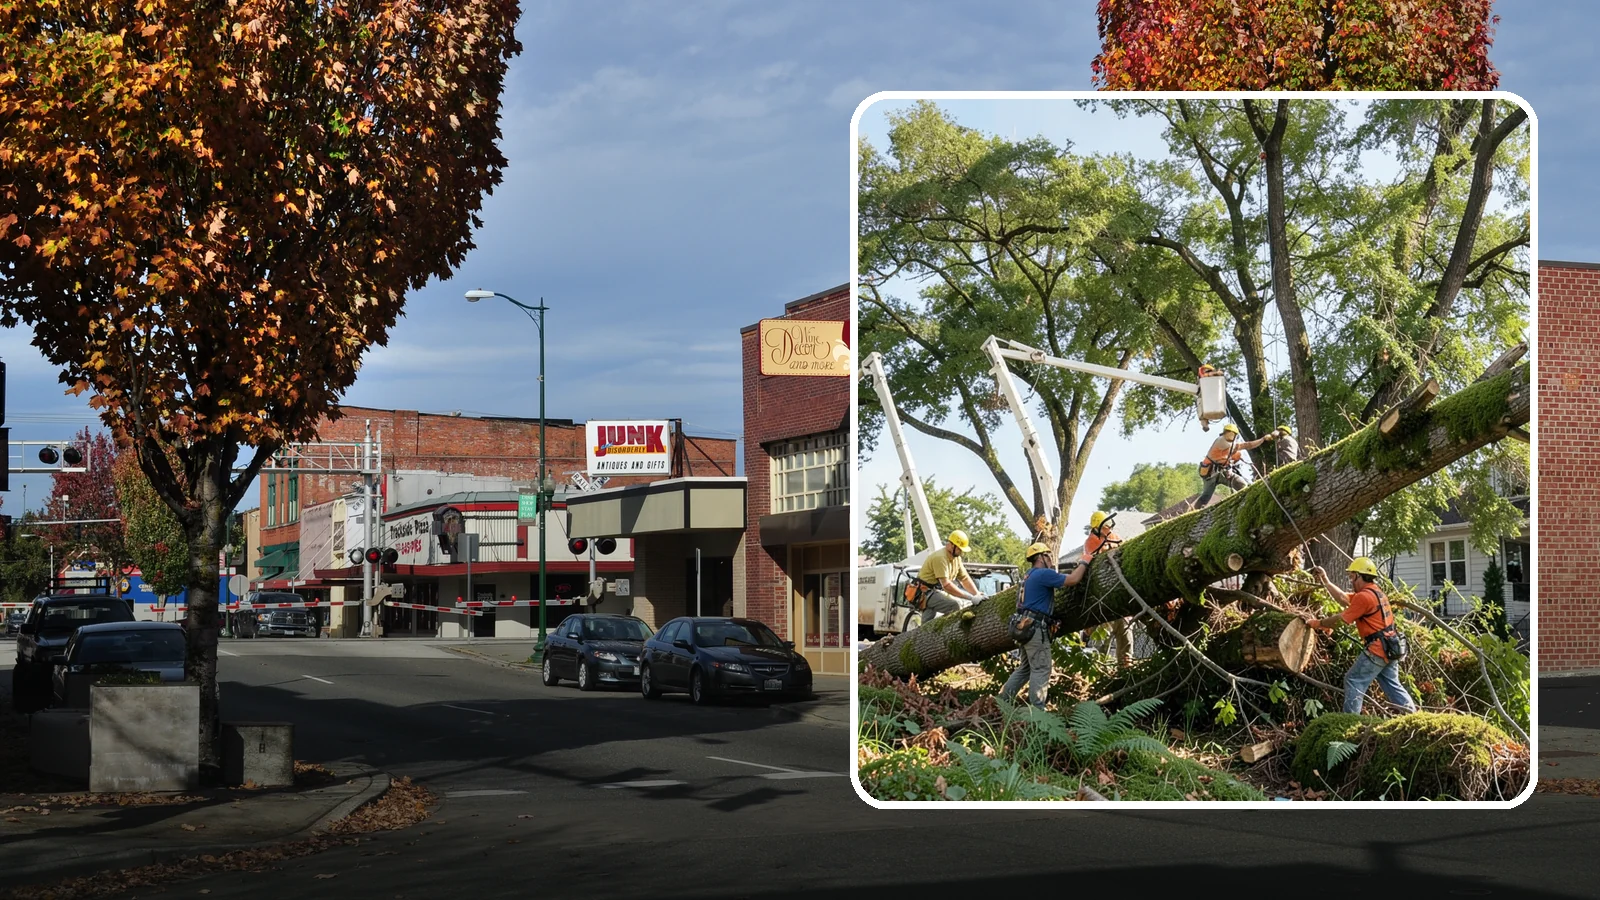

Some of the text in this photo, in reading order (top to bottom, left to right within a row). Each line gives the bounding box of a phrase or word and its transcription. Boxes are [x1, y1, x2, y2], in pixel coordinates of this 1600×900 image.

[765, 328, 831, 365] Decor
[595, 425, 665, 457] JUNK
[607, 446, 646, 454] DISORDERLY
[597, 460, 665, 470] ANTIQUES AND GIFTS
[572, 473, 588, 491] RAIL
[414, 519, 429, 535] Pizza
